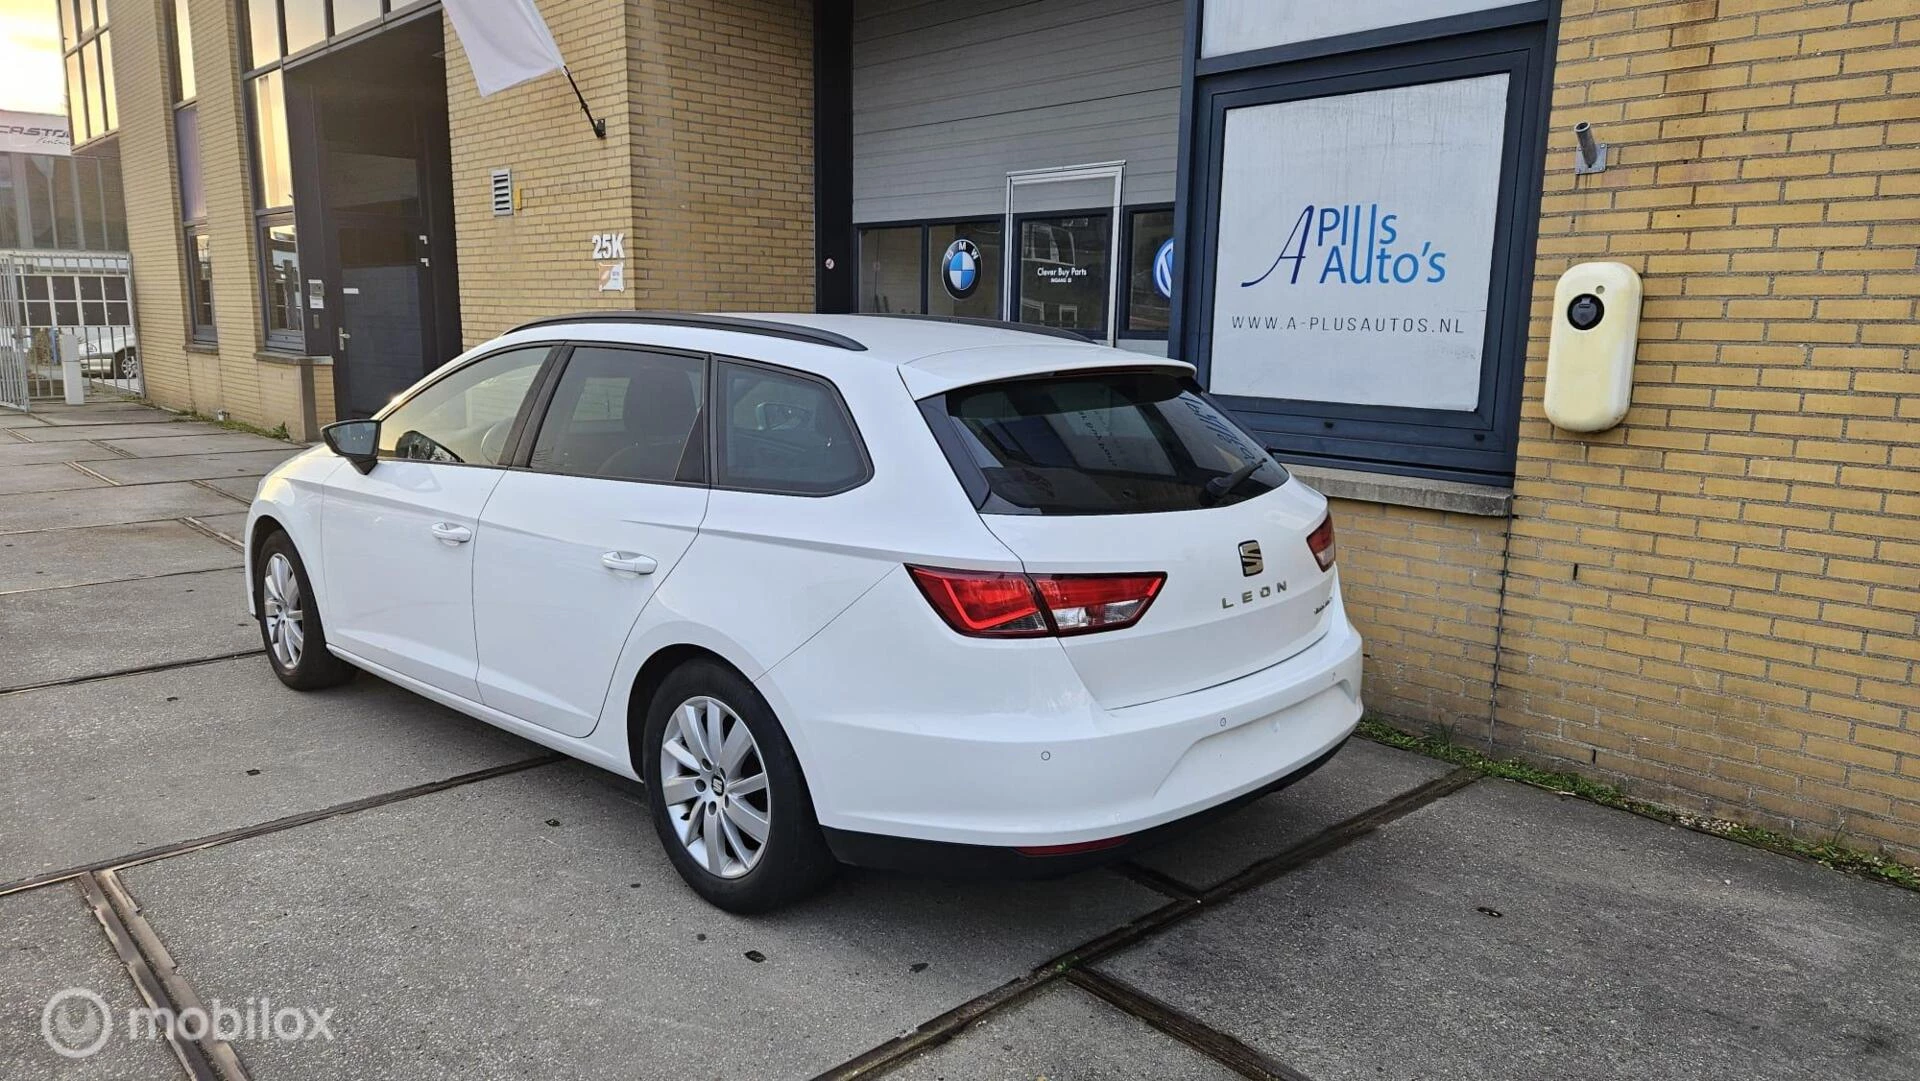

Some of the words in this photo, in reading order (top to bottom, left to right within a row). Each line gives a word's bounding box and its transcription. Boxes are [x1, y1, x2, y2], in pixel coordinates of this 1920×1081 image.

[591, 232, 626, 259] 25K
[1241, 205, 1315, 287] A
[1037, 267, 1056, 276] Clever
[1057, 267, 1070, 278] Buy
[1070, 267, 1087, 276] Parts
[1231, 315, 1465, 335] WWW.A-PLUSAUTOS.NL
[1221, 580, 1288, 609] LEON
